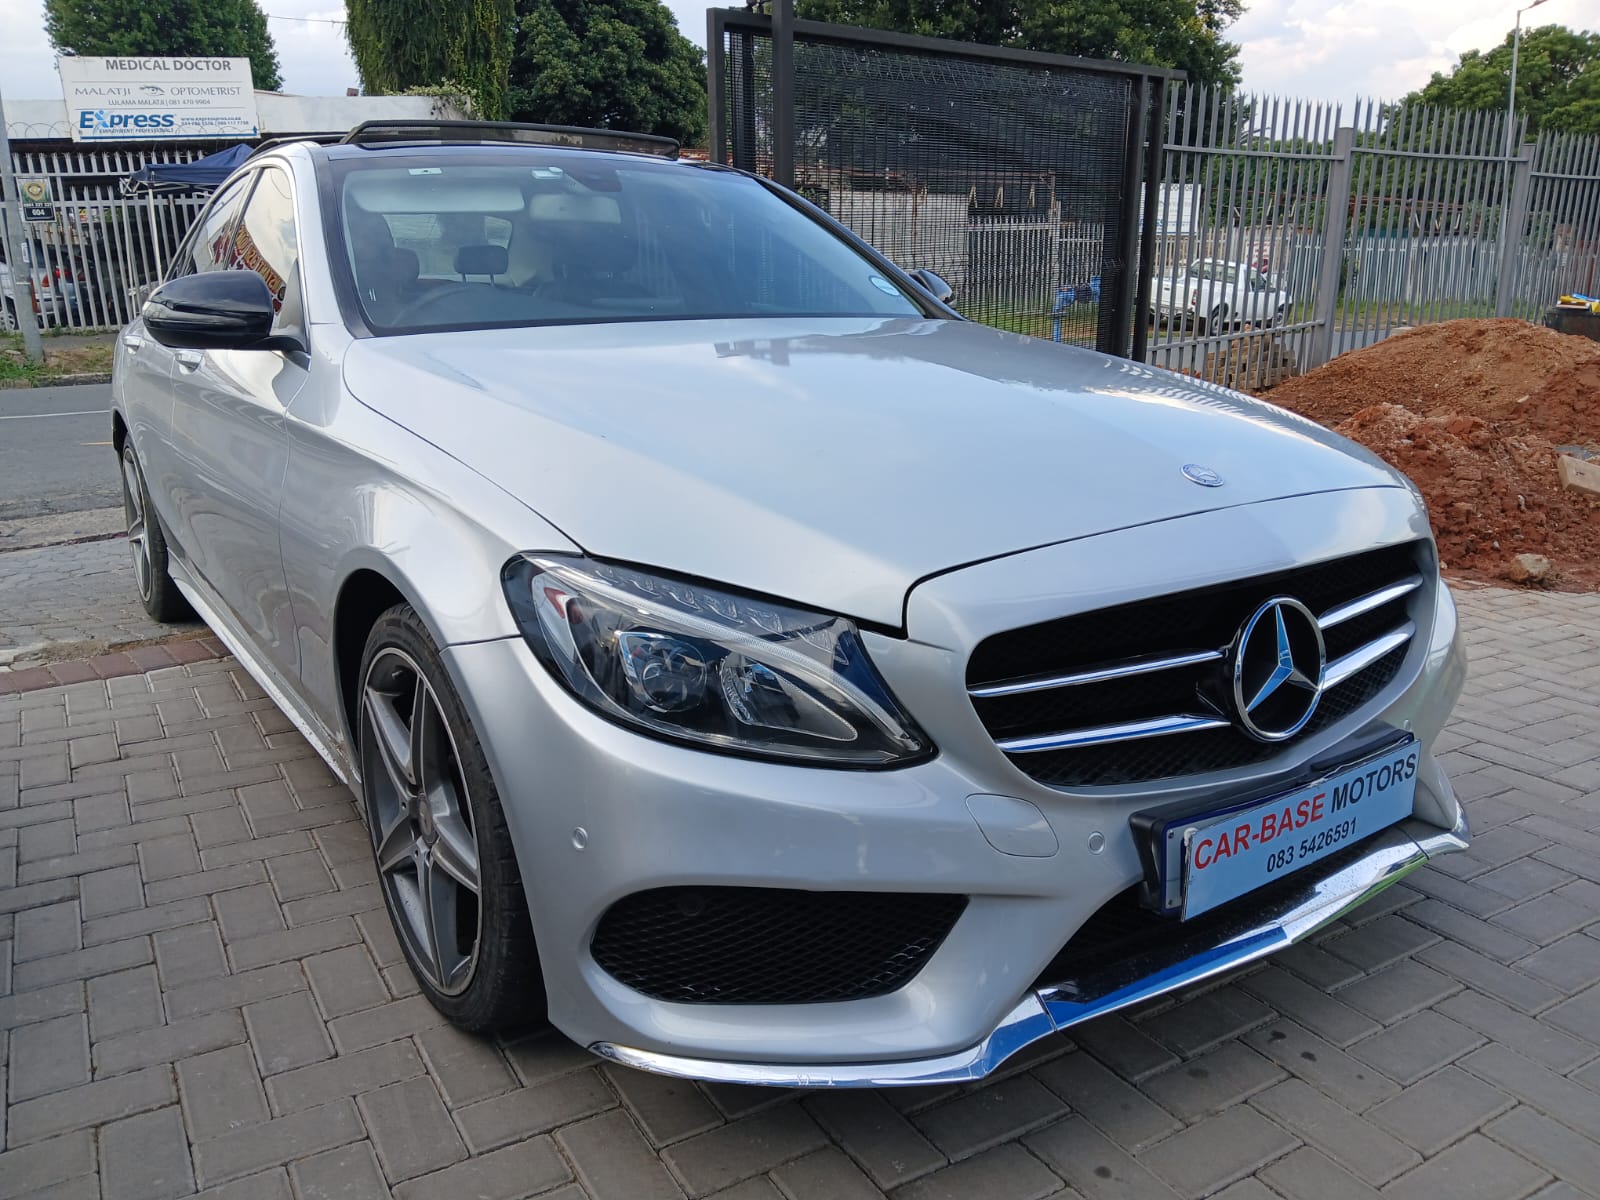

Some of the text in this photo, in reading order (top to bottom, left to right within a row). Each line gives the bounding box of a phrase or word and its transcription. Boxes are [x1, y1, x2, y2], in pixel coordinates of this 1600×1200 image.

[105, 60, 232, 71] MEDICAL DOCTOR
[75, 86, 241, 96] MALATJI OPTOMETRIST
[80, 109, 175, 128] Express
[1194, 753, 1417, 869] CAR-BASE MOTORS
[1266, 816, 1357, 873] 083 5426591
